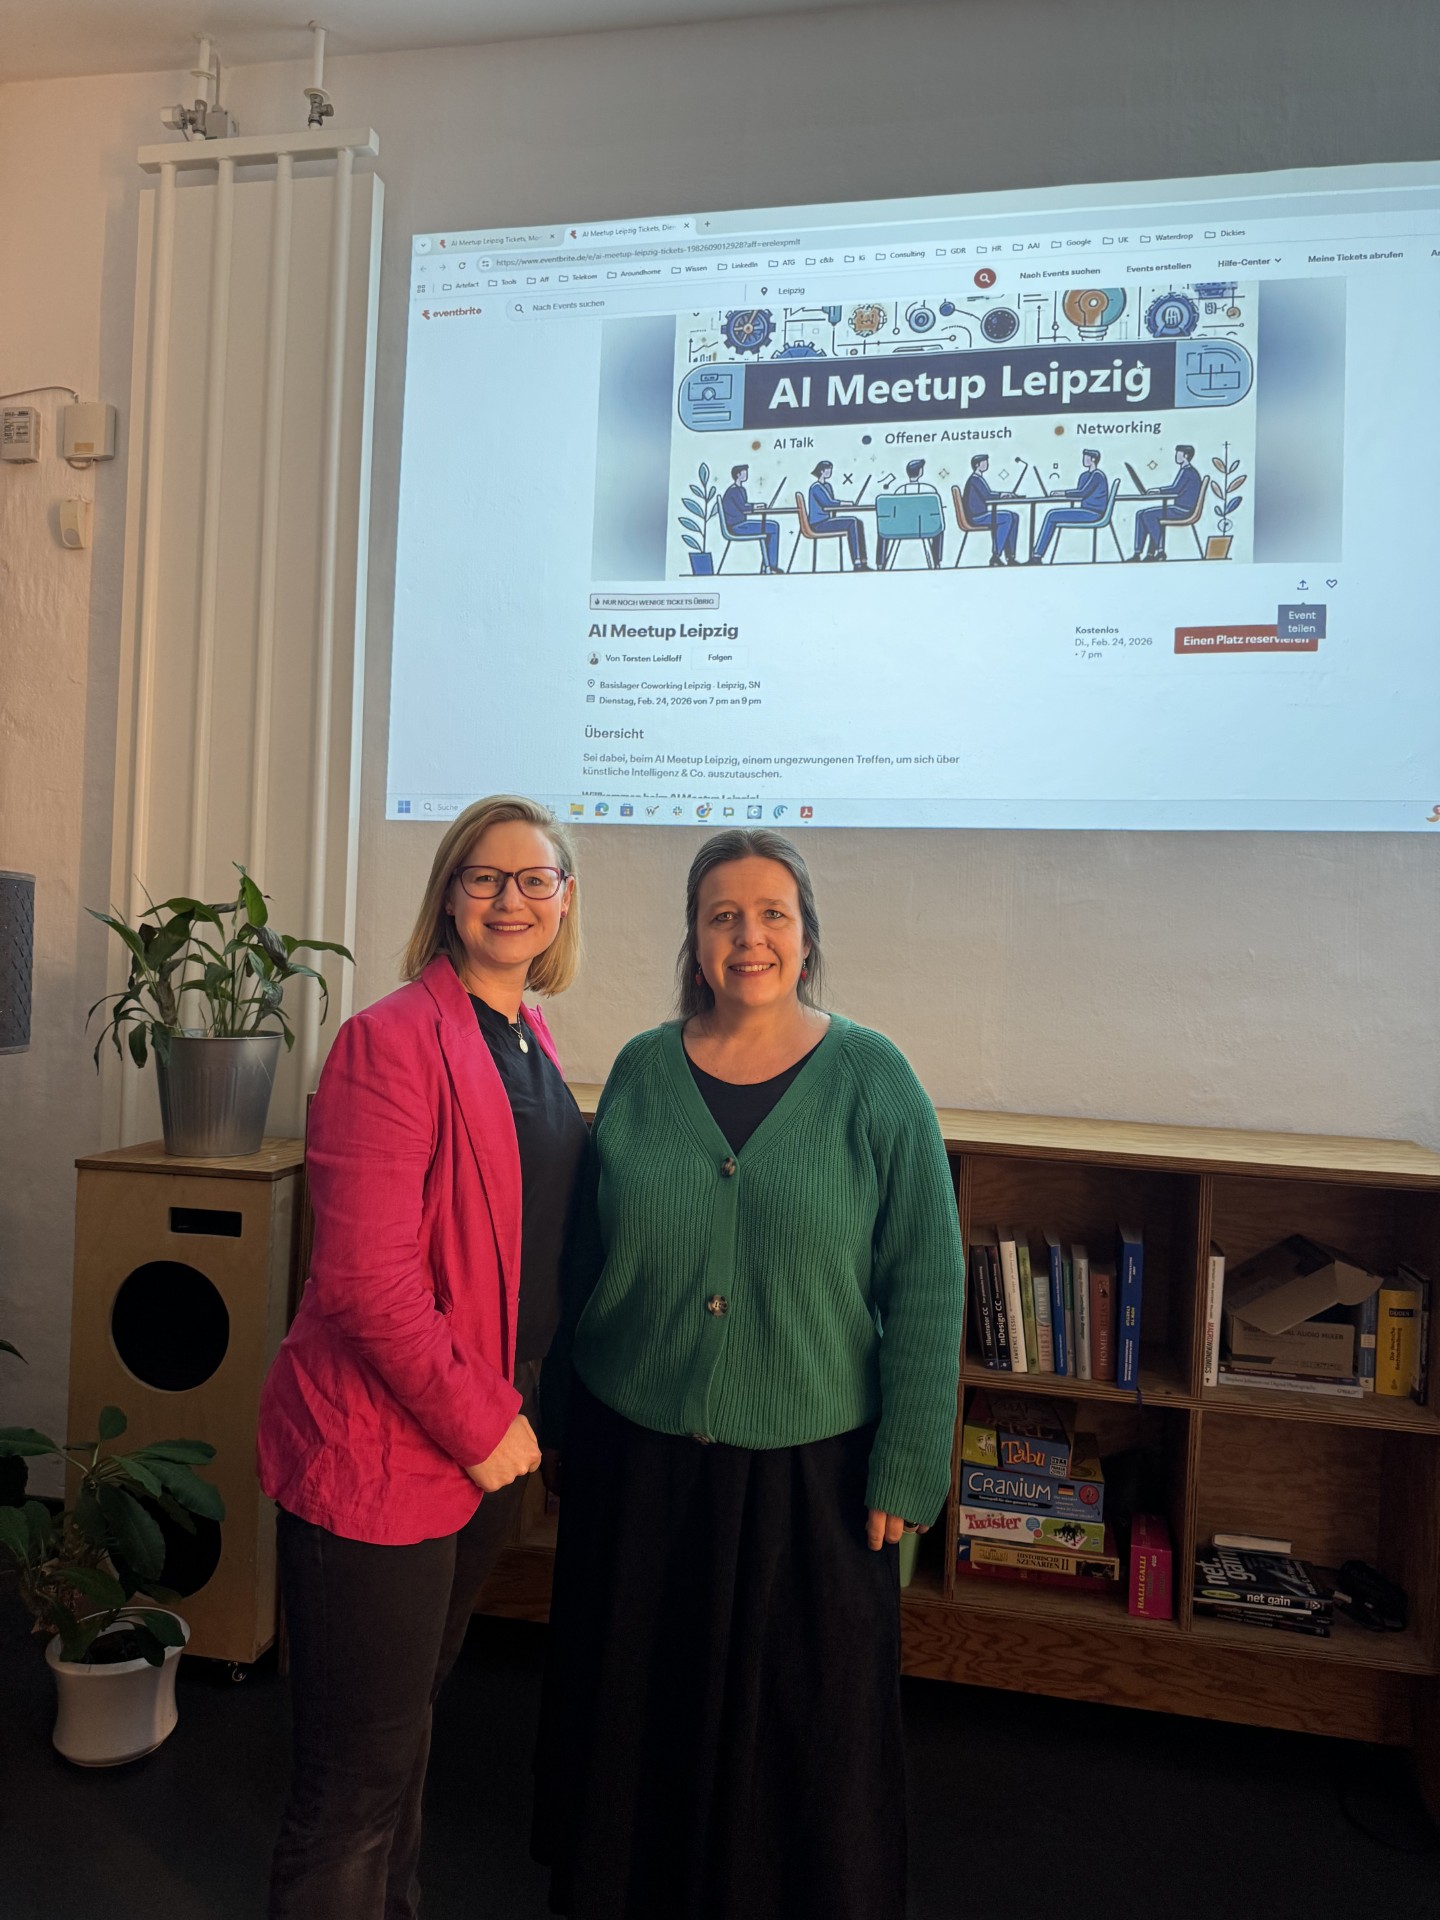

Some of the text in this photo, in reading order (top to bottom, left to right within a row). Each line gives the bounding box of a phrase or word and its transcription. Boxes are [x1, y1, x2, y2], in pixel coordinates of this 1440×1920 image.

[582, 230, 590, 238] AI
[590, 228, 614, 238] Meetup
[615, 226, 637, 236] Leipzig
[459, 239, 481, 247] Meetup
[483, 237, 504, 245] Leipzig
[456, 281, 480, 289] Artefact
[572, 273, 598, 281] Telekom
[620, 268, 662, 277] Aroundhome
[685, 264, 708, 273] Wissen
[731, 261, 758, 270] LinkedIn
[890, 250, 926, 260] Consulting
[991, 244, 1002, 252] HR
[1066, 238, 1092, 247] Google
[1117, 236, 1129, 244] UK
[1155, 232, 1194, 242] Waterdrop
[1220, 229, 1246, 238] Dickies
[1217, 257, 1271, 268] Hilfe-Center
[1308, 250, 1404, 264] Meine Tickets abrufen
[1020, 267, 1101, 280] Nach Events suchen
[1126, 261, 1192, 273] Events erstellen
[778, 286, 806, 296] Leipzig
[433, 306, 482, 318] eventbrite
[532, 299, 606, 312] Nach Events suchen
[768, 358, 1152, 409] AI Meetup Leipzig
[1076, 419, 1162, 436] Networking
[884, 425, 1012, 445] Offener Austausch
[773, 436, 814, 449] AI Talk
[1288, 610, 1317, 620] Event
[588, 623, 739, 641] AI Meetup Leipzig
[1075, 626, 1119, 634] Kostenlos
[1288, 624, 1316, 634] teilen
[1075, 637, 1153, 647] Di., Feb. 24, 2026
[1183, 636, 1215, 646] Einen
[1216, 635, 1244, 645] Platz
[622, 654, 651, 663] Torsten
[653, 653, 683, 663] Leidloff
[708, 653, 733, 663] Folgen
[1080, 650, 1103, 660] 7 pm
[600, 680, 761, 691] Basislager Coworking Leipzig Leipzig, SN
[599, 696, 762, 707] Dienstag, Feb. 24, 2026 von 7 pm an 9 pm
[584, 725, 645, 740] Übersicht
[583, 753, 960, 768] Sei dabei, beim AI Meetup Leipzig, einem ungezwungenen Treffen, um sich über
[583, 766, 783, 779] künstliche Intelligenz & Co. auszutauschen.
[982, 1306, 989, 1316] CC
[994, 1299, 1003, 1312] CC
[997, 1312, 1006, 1346] InDesign
[1321, 1332, 1344, 1340] MIXER
[1012, 1335, 1020, 1364] LAWRENCE
[1100, 1329, 1108, 1366] HOMER
[1204, 1321, 1214, 1374] MACROWIKINOMICS
[1001, 1440, 1046, 1467] Tabu
[965, 1513, 1022, 1530] Twister
[1016, 1558, 1069, 1570] SZENARIEN II
[1017, 1552, 1060, 1563] HISTORISCHE
[1218, 1551, 1257, 1582] gain
[1137, 1555, 1147, 1609] HALLI GALLI
[1247, 1593, 1265, 1604] net
[1267, 1595, 1291, 1607] gain
